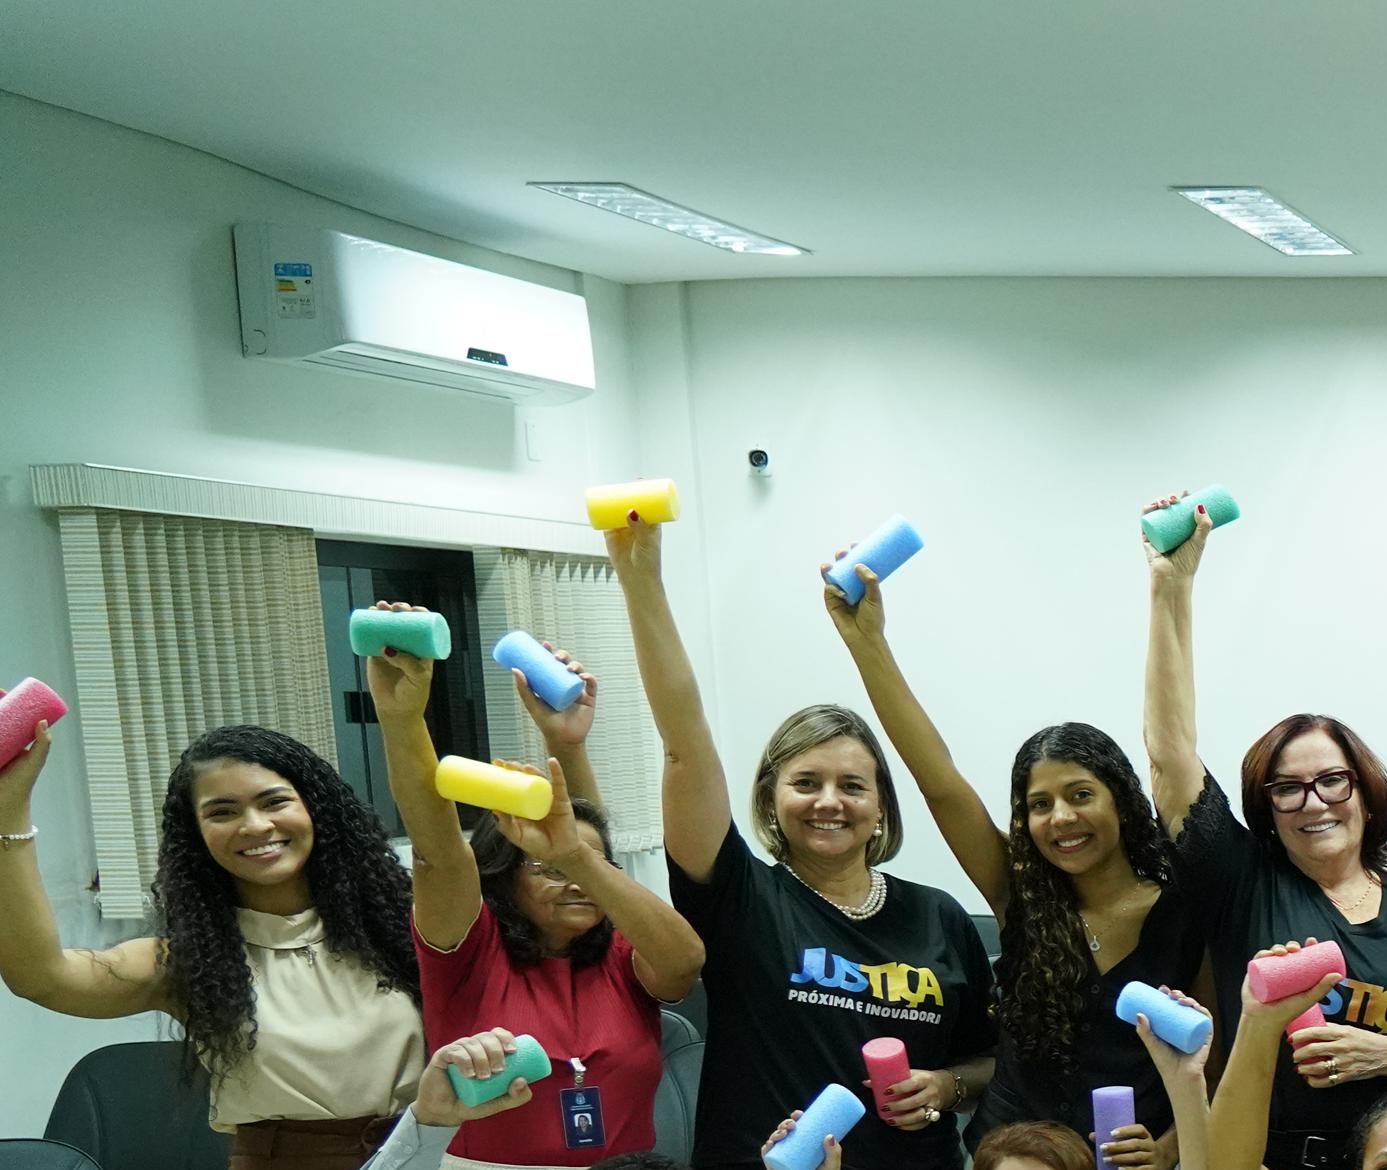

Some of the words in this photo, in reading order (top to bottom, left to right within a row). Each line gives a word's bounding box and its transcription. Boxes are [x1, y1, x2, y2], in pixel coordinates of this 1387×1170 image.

[790, 947, 945, 1009] JUSTIÇA
[788, 989, 855, 1011] PRÓXIMA
[855, 1001, 863, 1013] E
